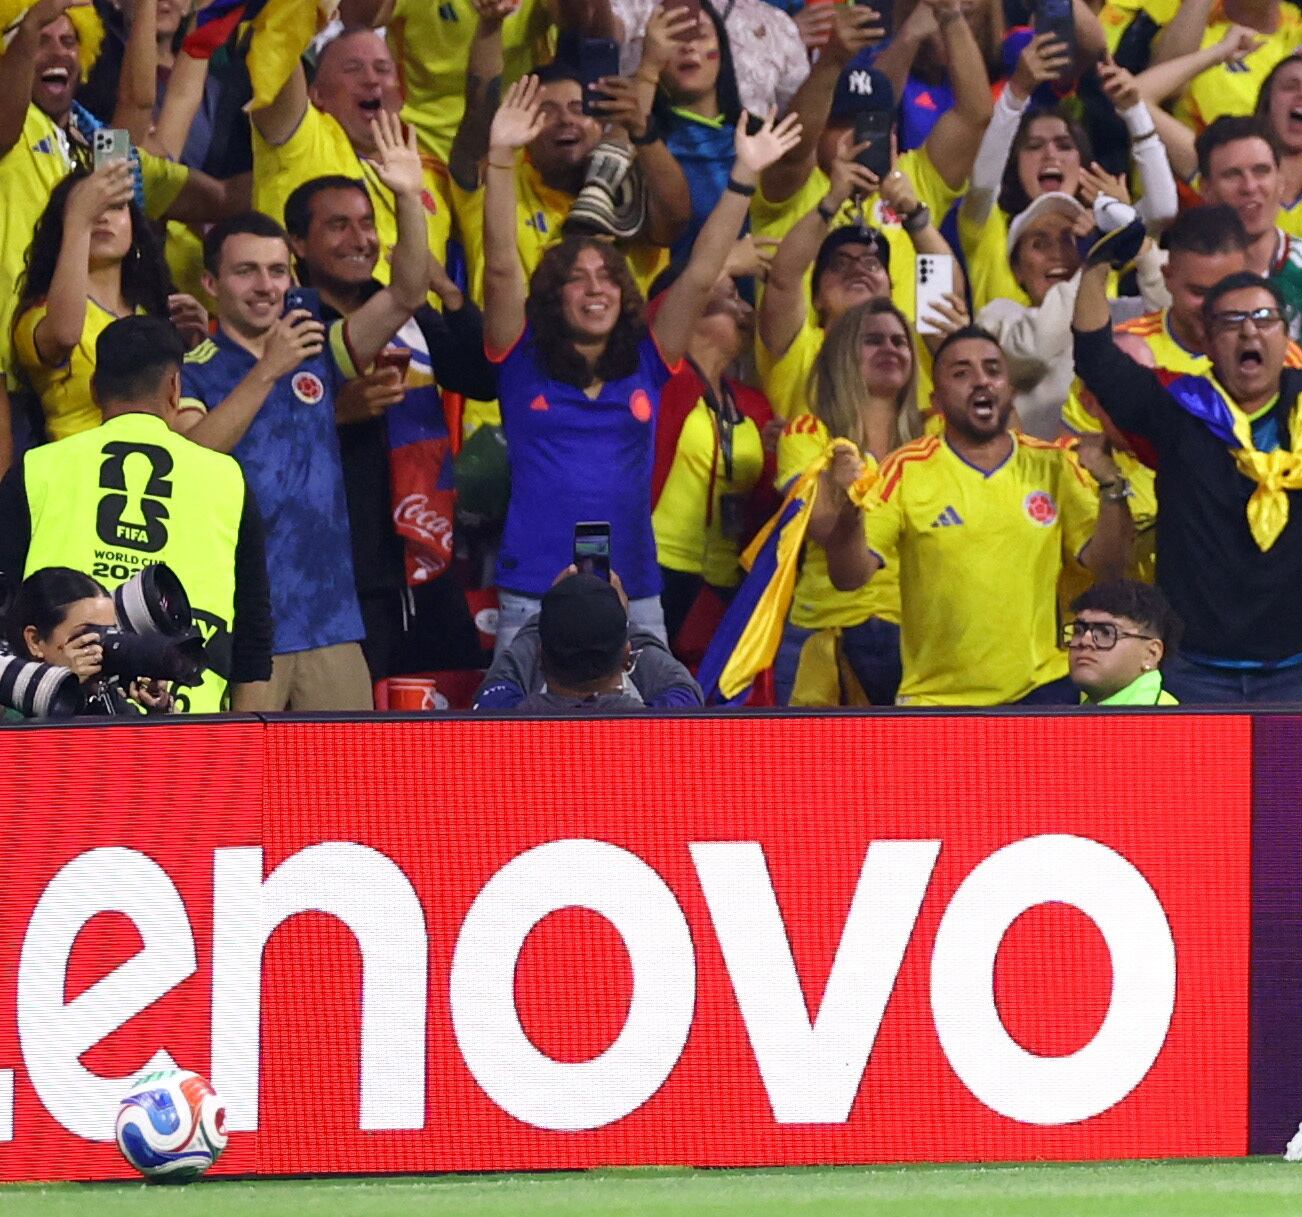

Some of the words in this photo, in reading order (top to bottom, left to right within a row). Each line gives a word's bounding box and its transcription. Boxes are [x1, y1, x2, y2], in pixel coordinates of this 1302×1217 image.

[116, 524, 149, 544] FIFA
[94, 549, 139, 565] WORLD
[0, 833, 1176, 1142] enovo
